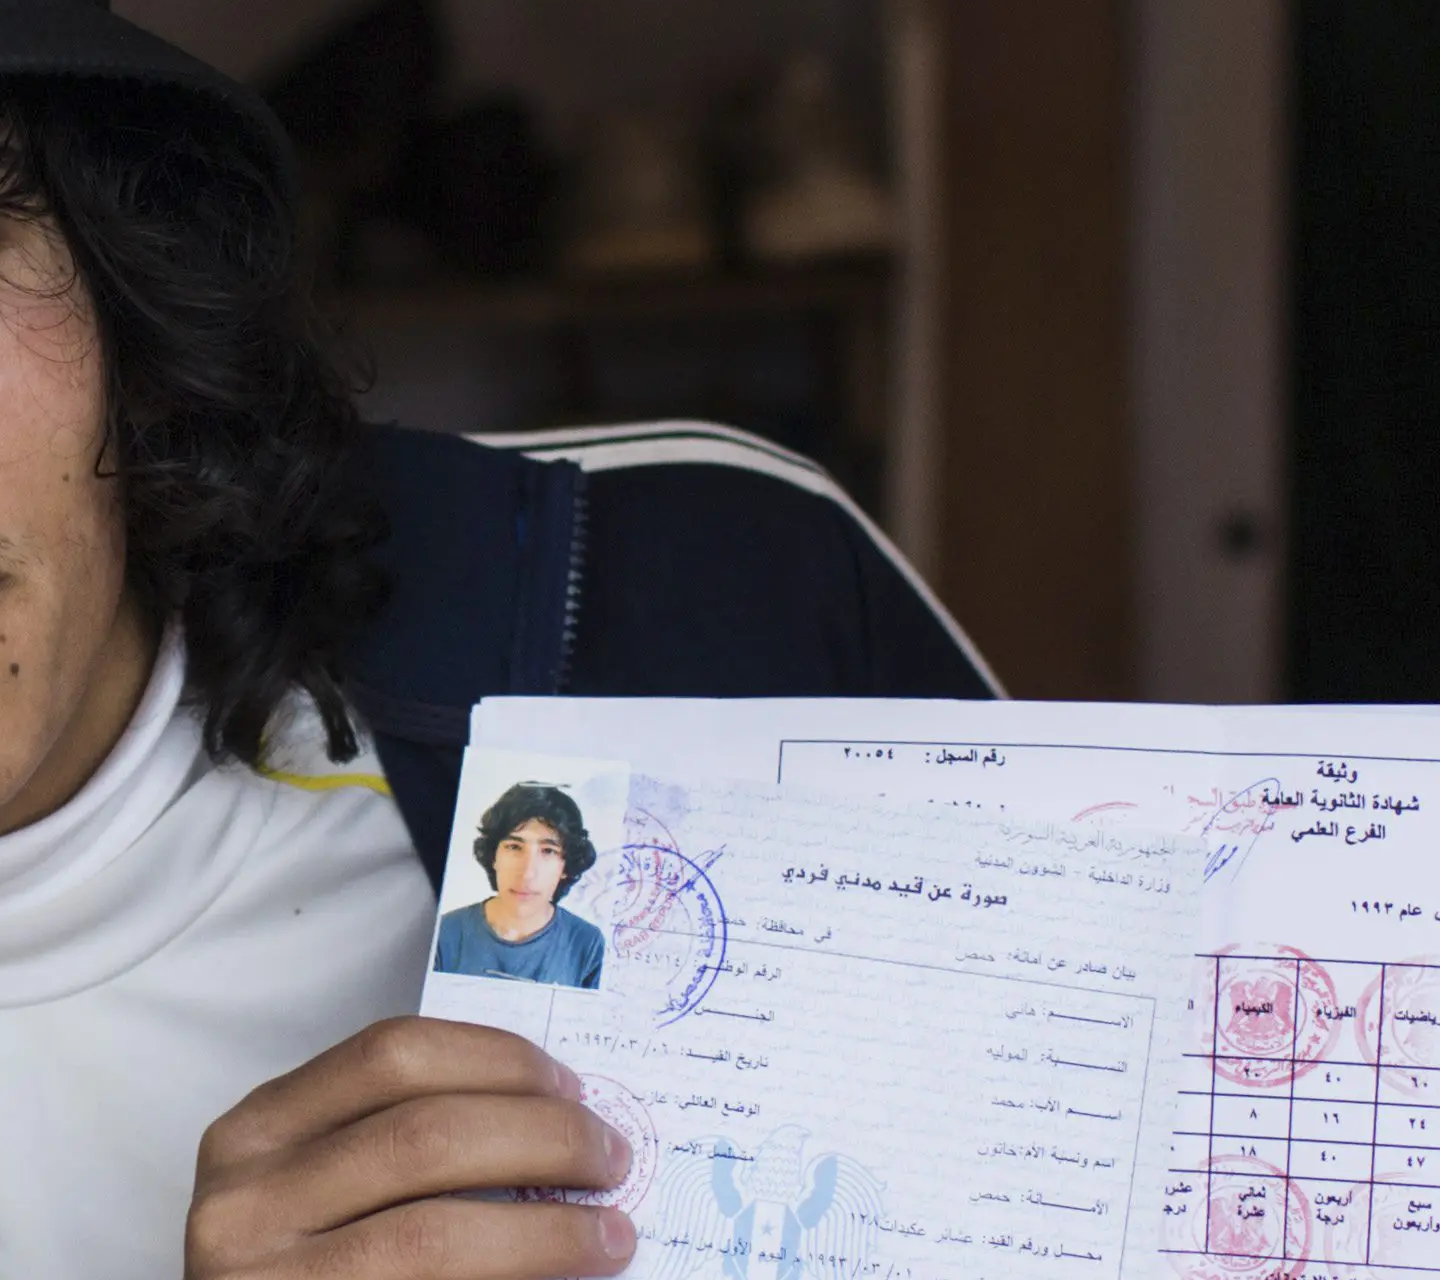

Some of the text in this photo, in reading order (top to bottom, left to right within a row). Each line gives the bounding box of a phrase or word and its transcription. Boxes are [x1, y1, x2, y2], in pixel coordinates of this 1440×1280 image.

[845, 747, 893, 760] ٢٠٠٥٤
[1317, 761, 1357, 782] وثيقة
[1262, 789, 1303, 806] العامة
[1311, 792, 1365, 812] الثانوية
[1373, 794, 1420, 816] شهادة
[1292, 822, 1338, 841] العلمي
[1345, 824, 1386, 845] الفرع
[782, 864, 1007, 908] صورة عن قيد مدني فردي
[1351, 901, 1392, 914] ١٩٩٣
[1400, 905, 1422, 919] عام
[1316, 1211, 1344, 1223] درجة
